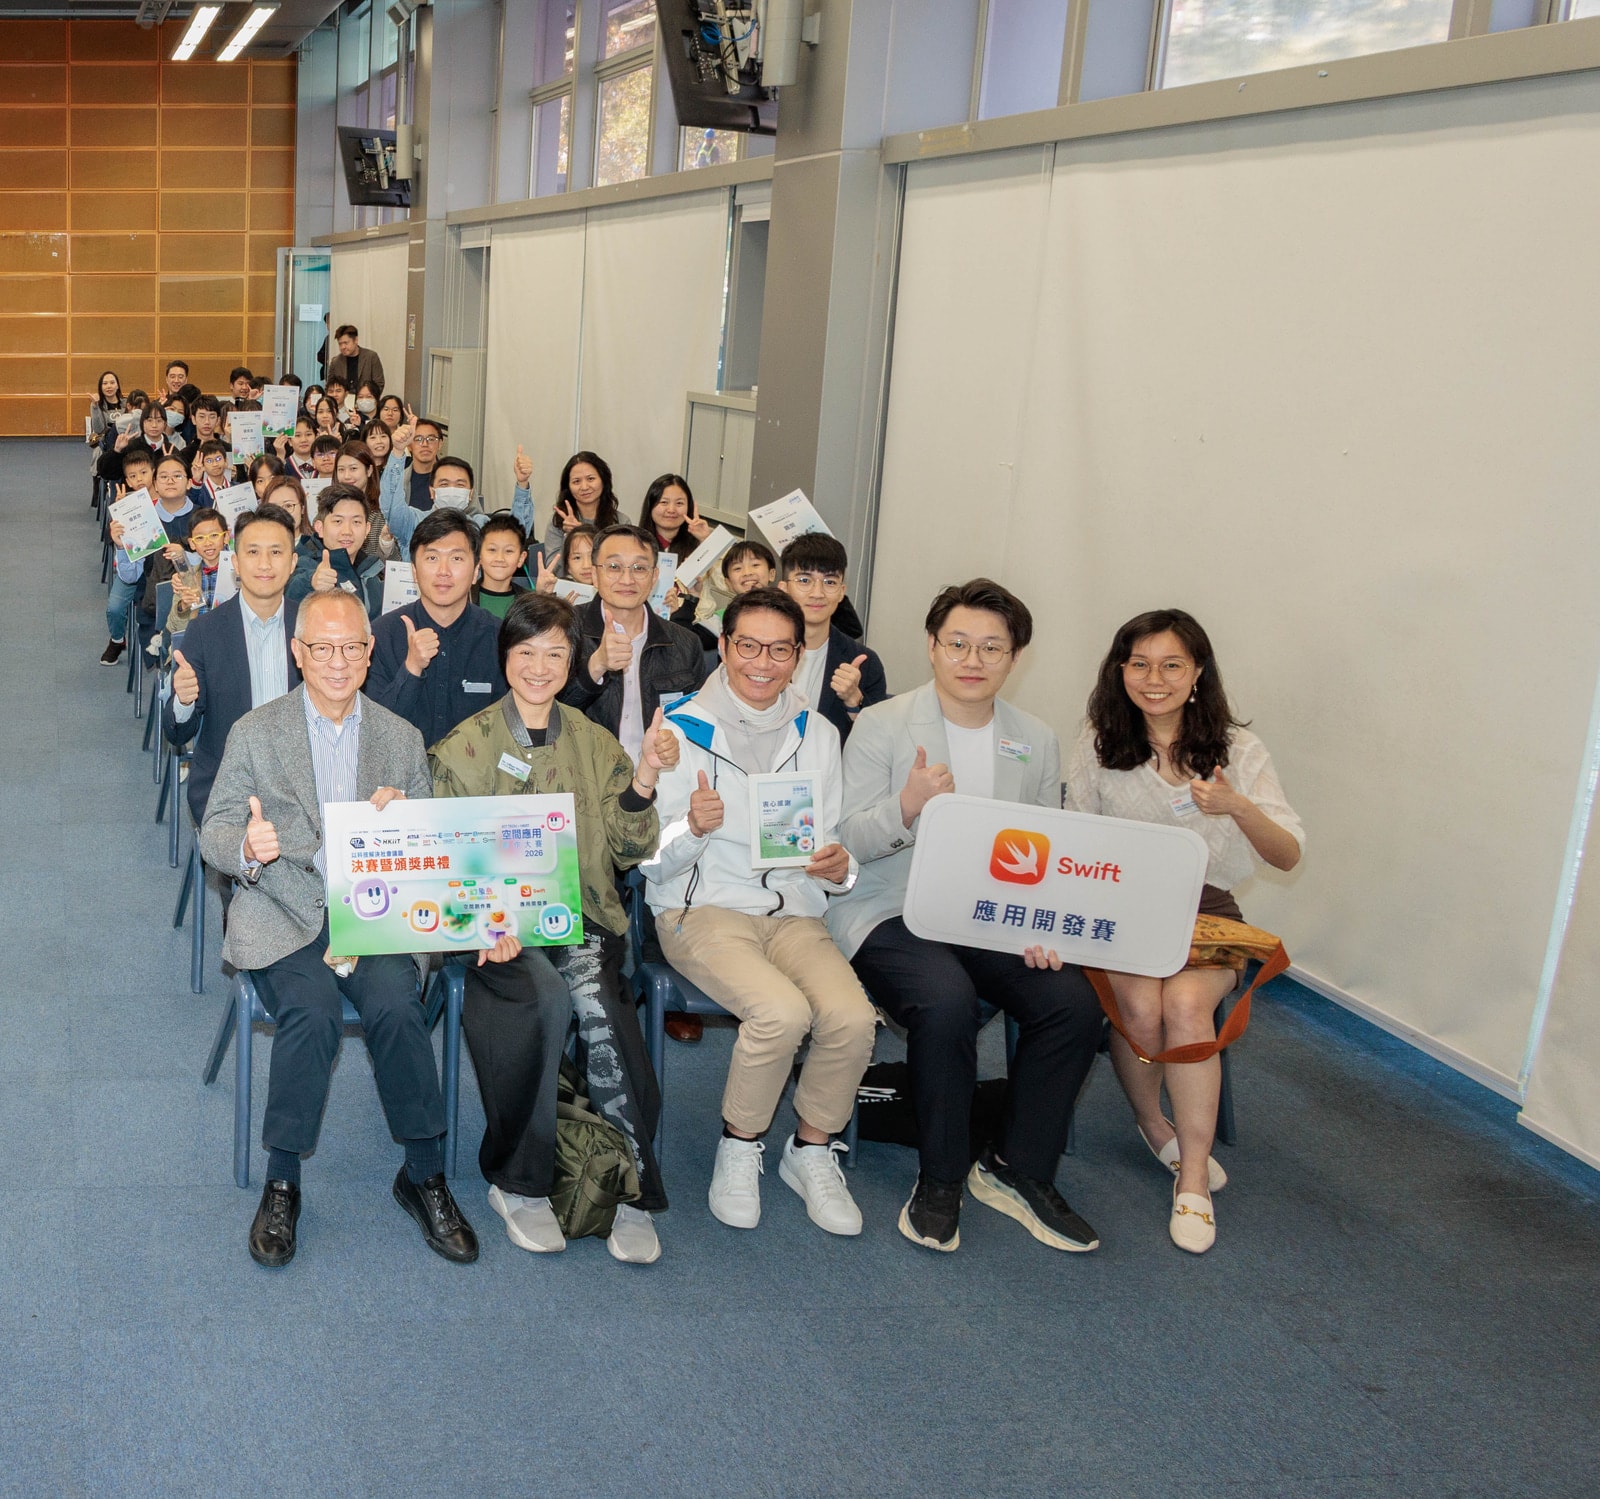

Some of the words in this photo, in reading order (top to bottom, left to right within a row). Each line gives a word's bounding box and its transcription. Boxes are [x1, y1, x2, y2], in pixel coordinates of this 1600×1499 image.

[501, 828, 542, 840] 空間應用
[351, 855, 450, 873] 決賽暨頒獎典禮
[1057, 857, 1121, 882] Swift
[972, 900, 1116, 942] 應用開發賽
